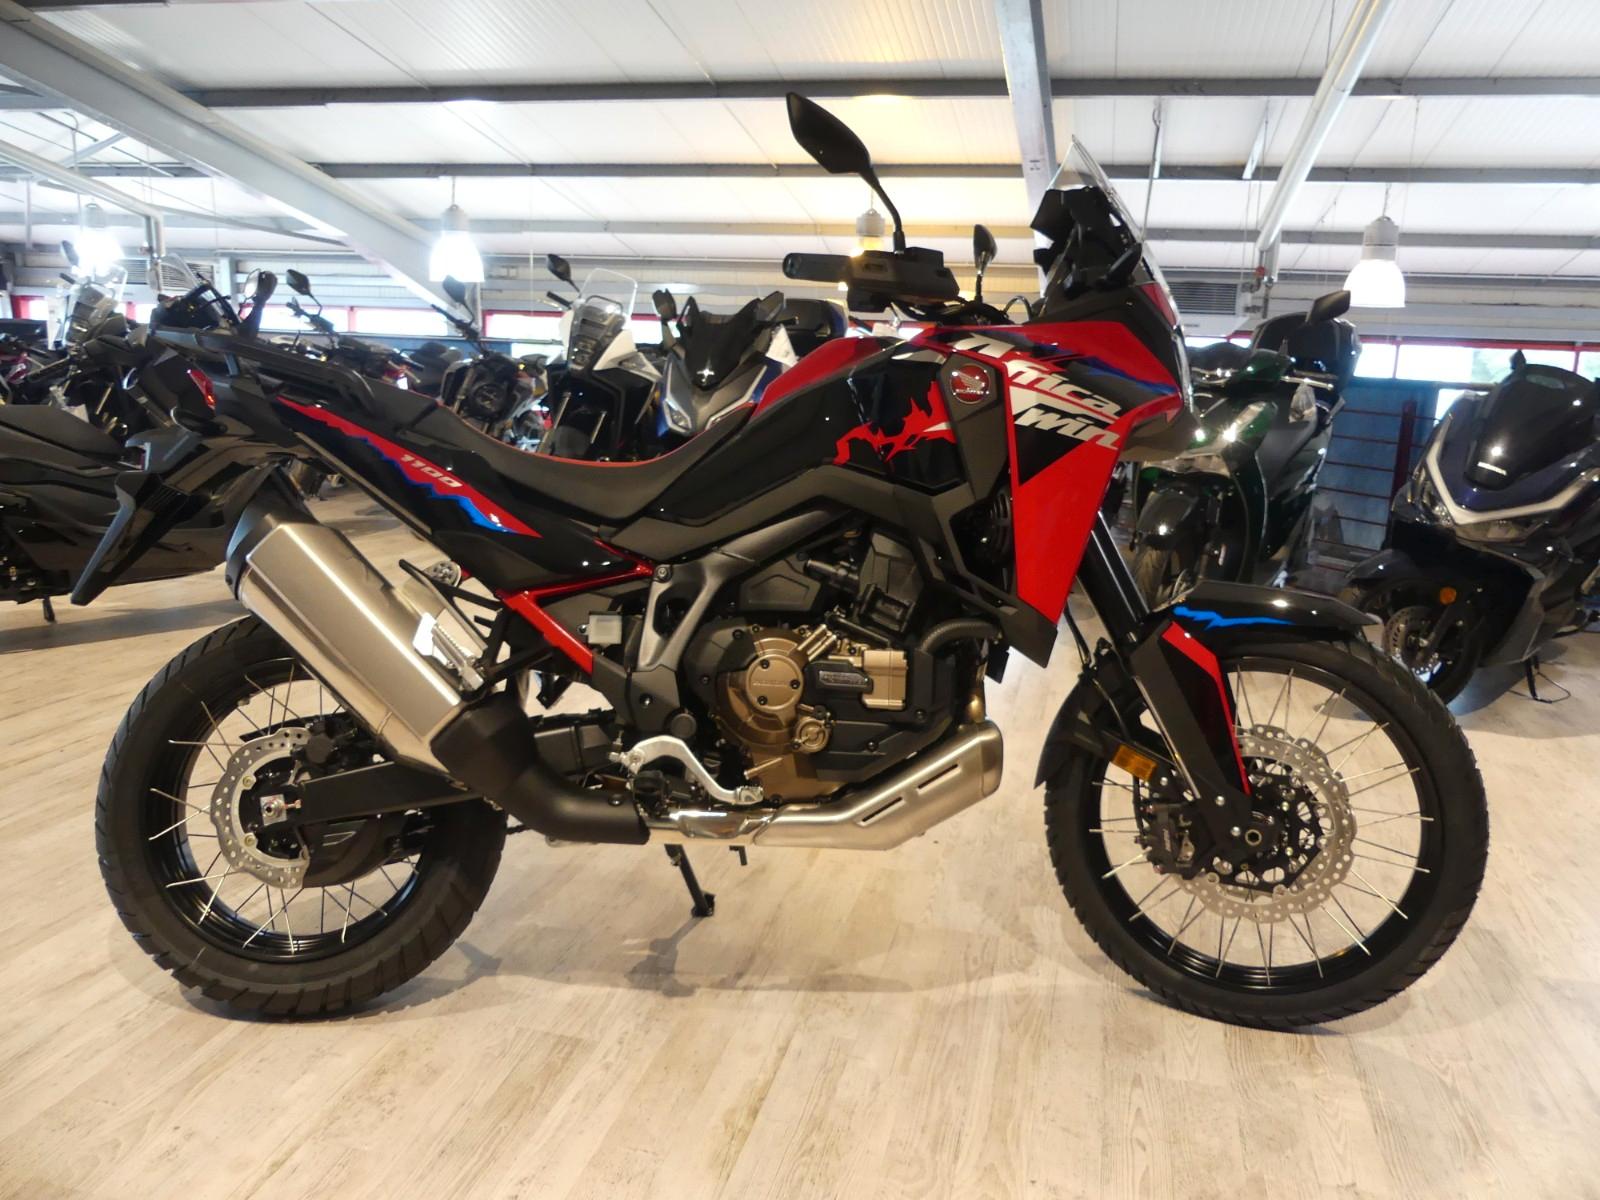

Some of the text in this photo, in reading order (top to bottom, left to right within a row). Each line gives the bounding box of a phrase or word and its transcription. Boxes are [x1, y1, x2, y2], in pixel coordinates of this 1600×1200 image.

[950, 332, 1122, 419] Africa
[1008, 385, 1121, 451] Twin
[400, 454, 463, 488] 1100
